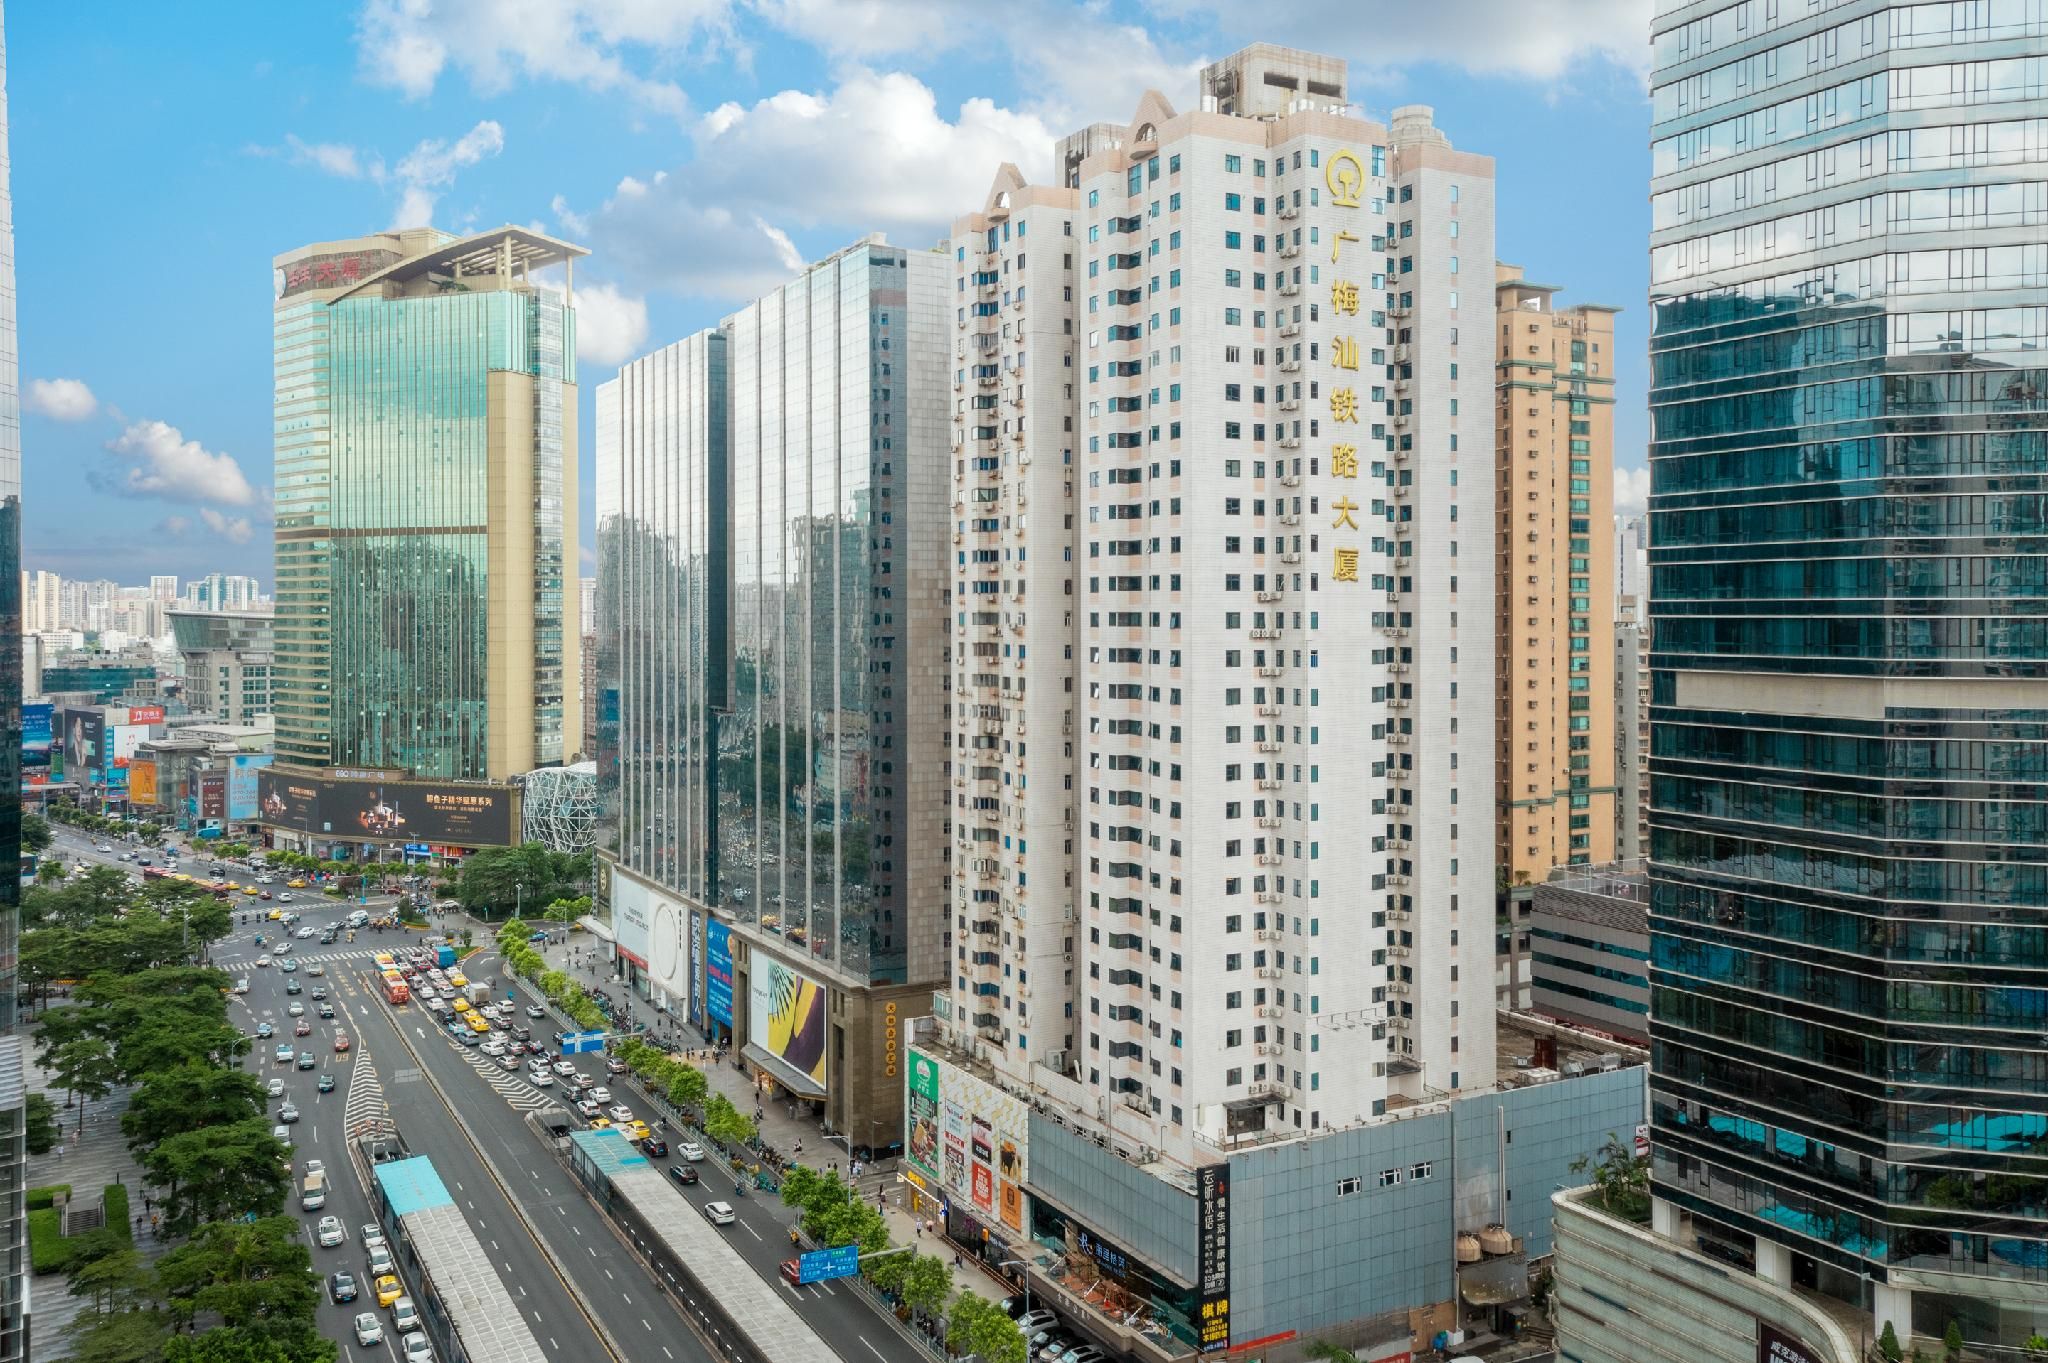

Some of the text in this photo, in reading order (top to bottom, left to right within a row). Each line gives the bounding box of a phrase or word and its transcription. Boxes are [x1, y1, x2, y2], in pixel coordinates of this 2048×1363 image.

[1330, 230, 1360, 583] 广梅汕铁路大厦
[1202, 1299, 1228, 1319] 棋牌
